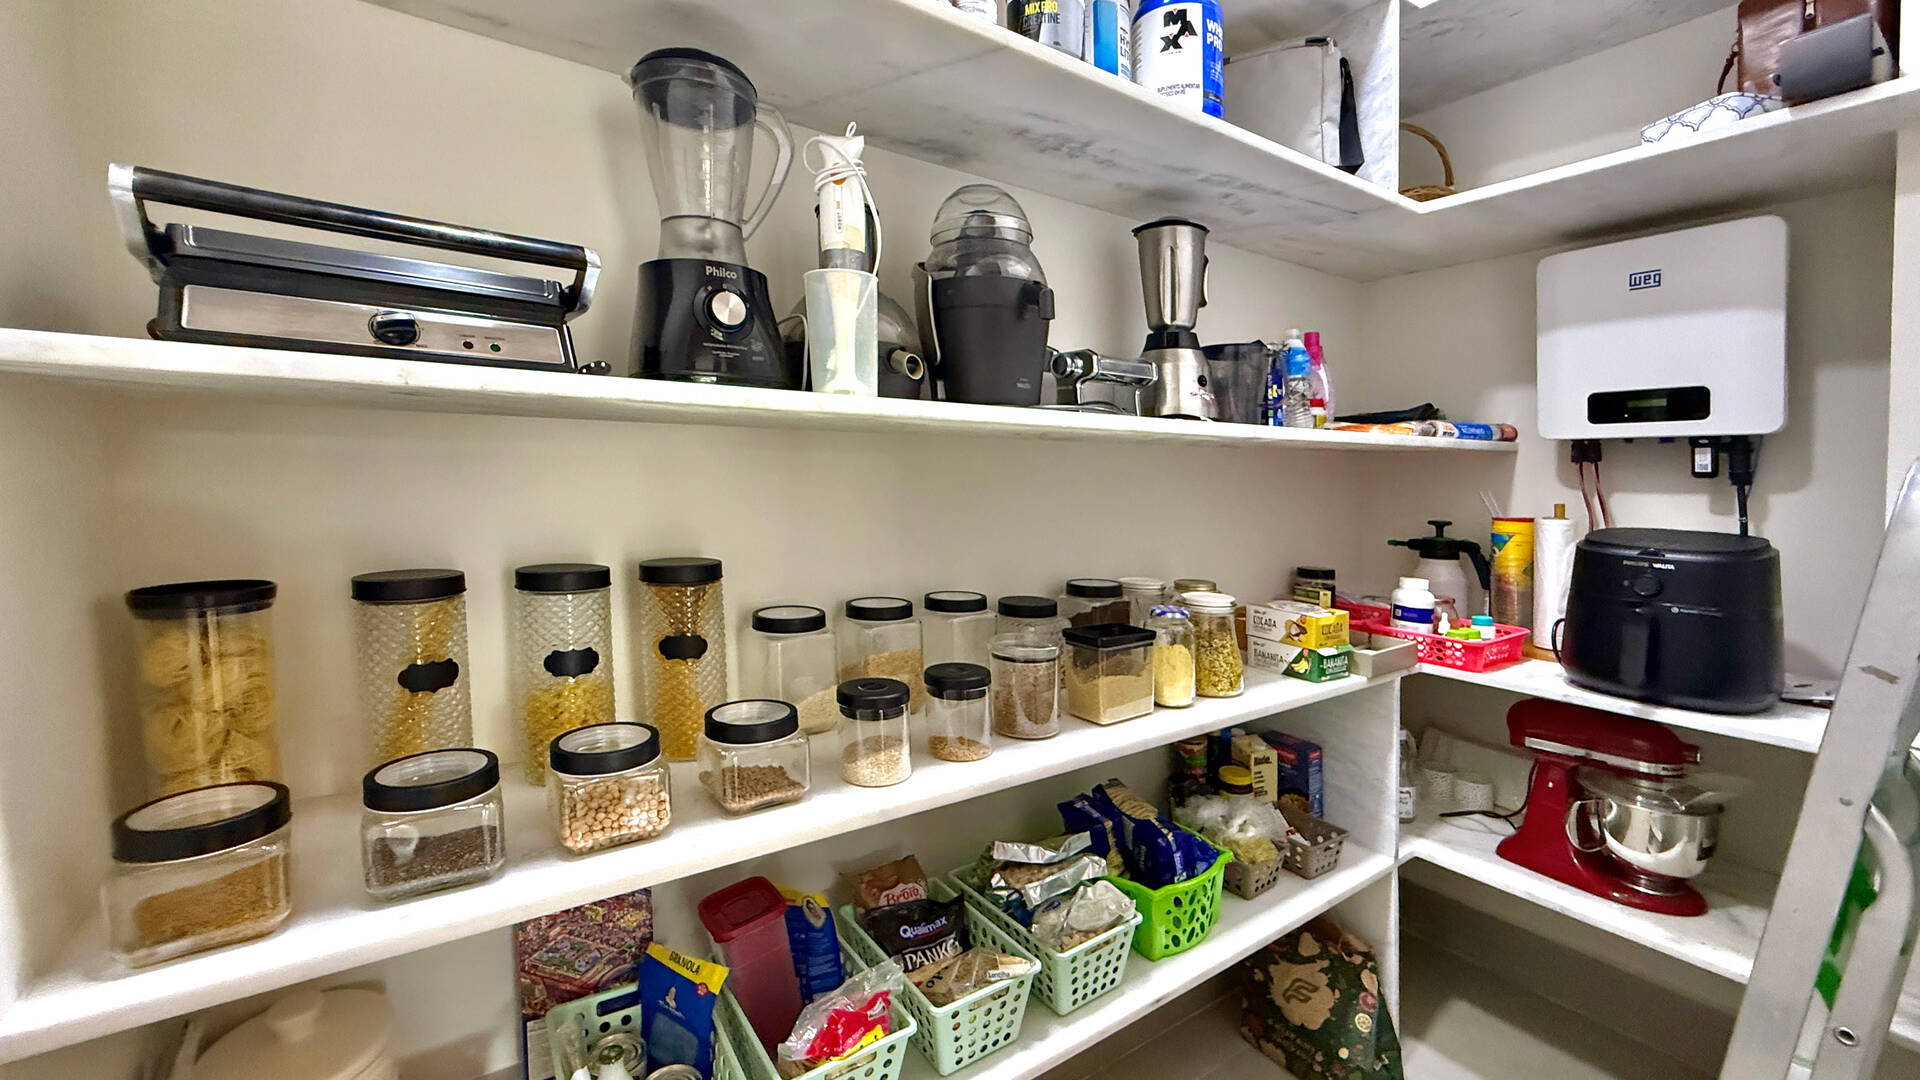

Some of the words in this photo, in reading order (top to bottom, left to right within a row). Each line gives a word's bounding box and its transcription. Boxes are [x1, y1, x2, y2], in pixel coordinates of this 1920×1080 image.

[1024, 2, 1040, 16] MIX
[1041, 0, 1058, 13] PRO
[705, 265, 737, 279] Philco
[899, 916, 948, 939] Qualimax
[669, 950, 701, 975] GRANOLA
